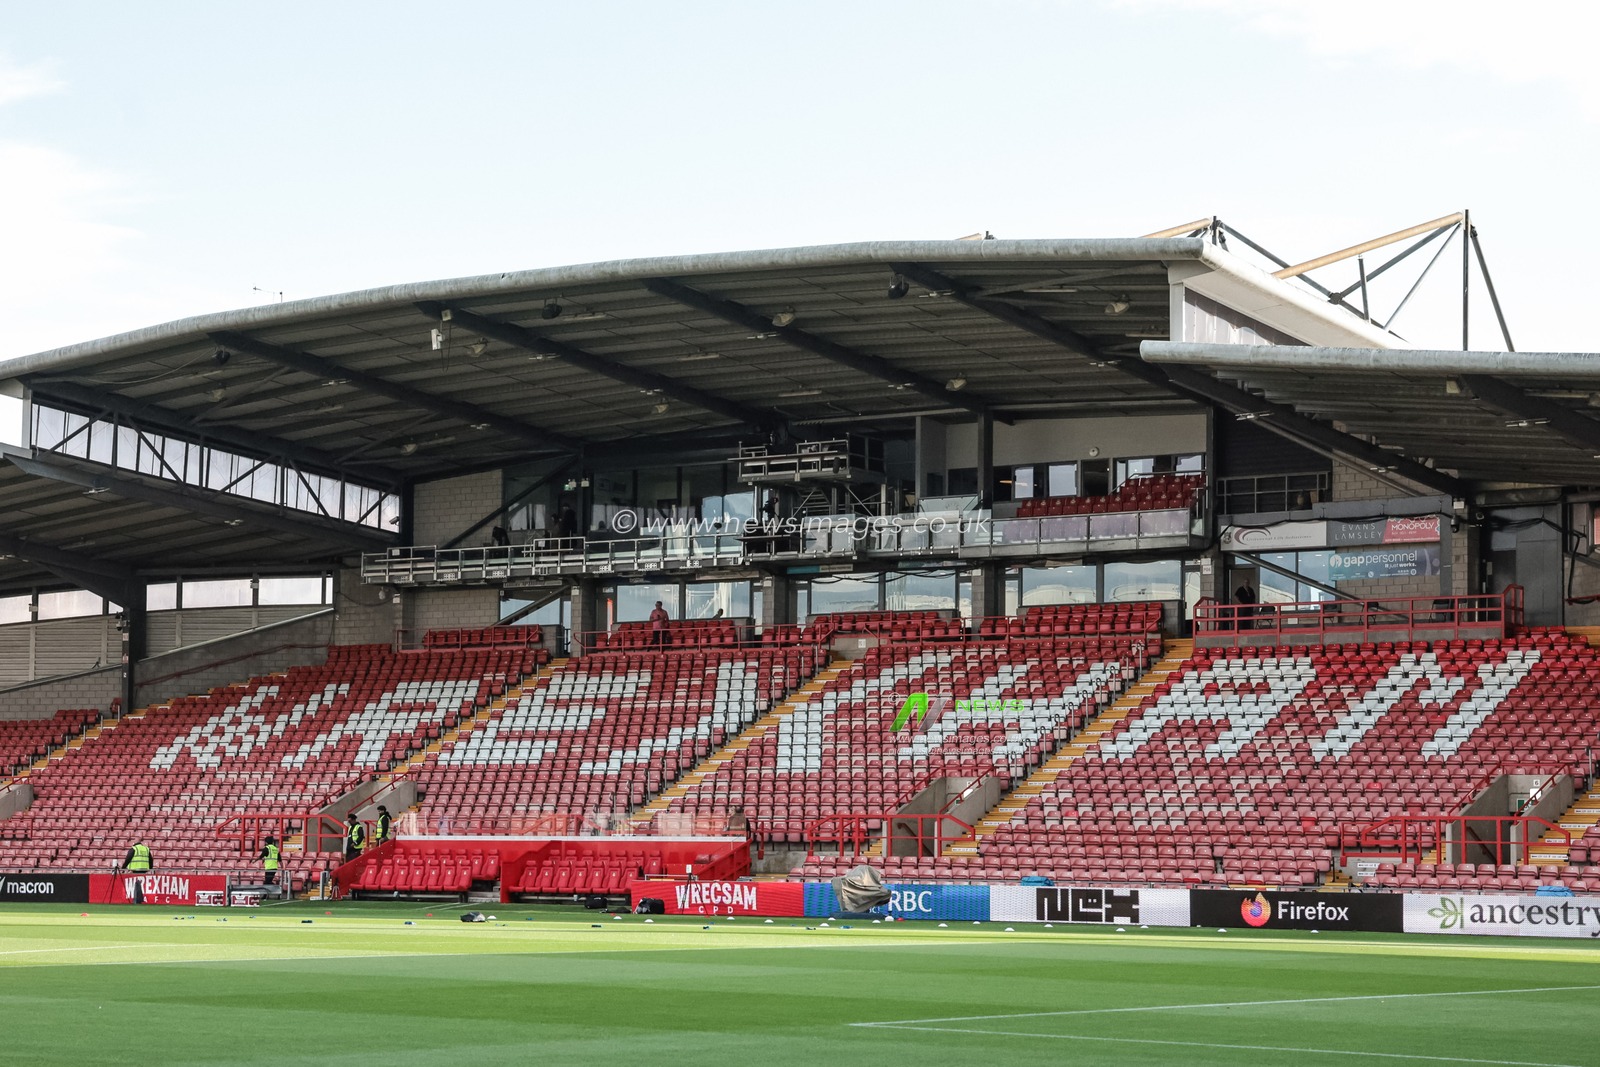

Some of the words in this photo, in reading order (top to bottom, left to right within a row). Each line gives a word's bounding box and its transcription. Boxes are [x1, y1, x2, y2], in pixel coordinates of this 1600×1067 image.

[1341, 523, 1376, 532] EVANS
[1391, 522, 1435, 532] MONOPOLY
[1335, 531, 1382, 541] LAMSLEY
[6, 880, 54, 895] macron
[675, 882, 758, 911] WRECSAM
[887, 890, 932, 913] RBC
[1277, 900, 1349, 922] Firefox
